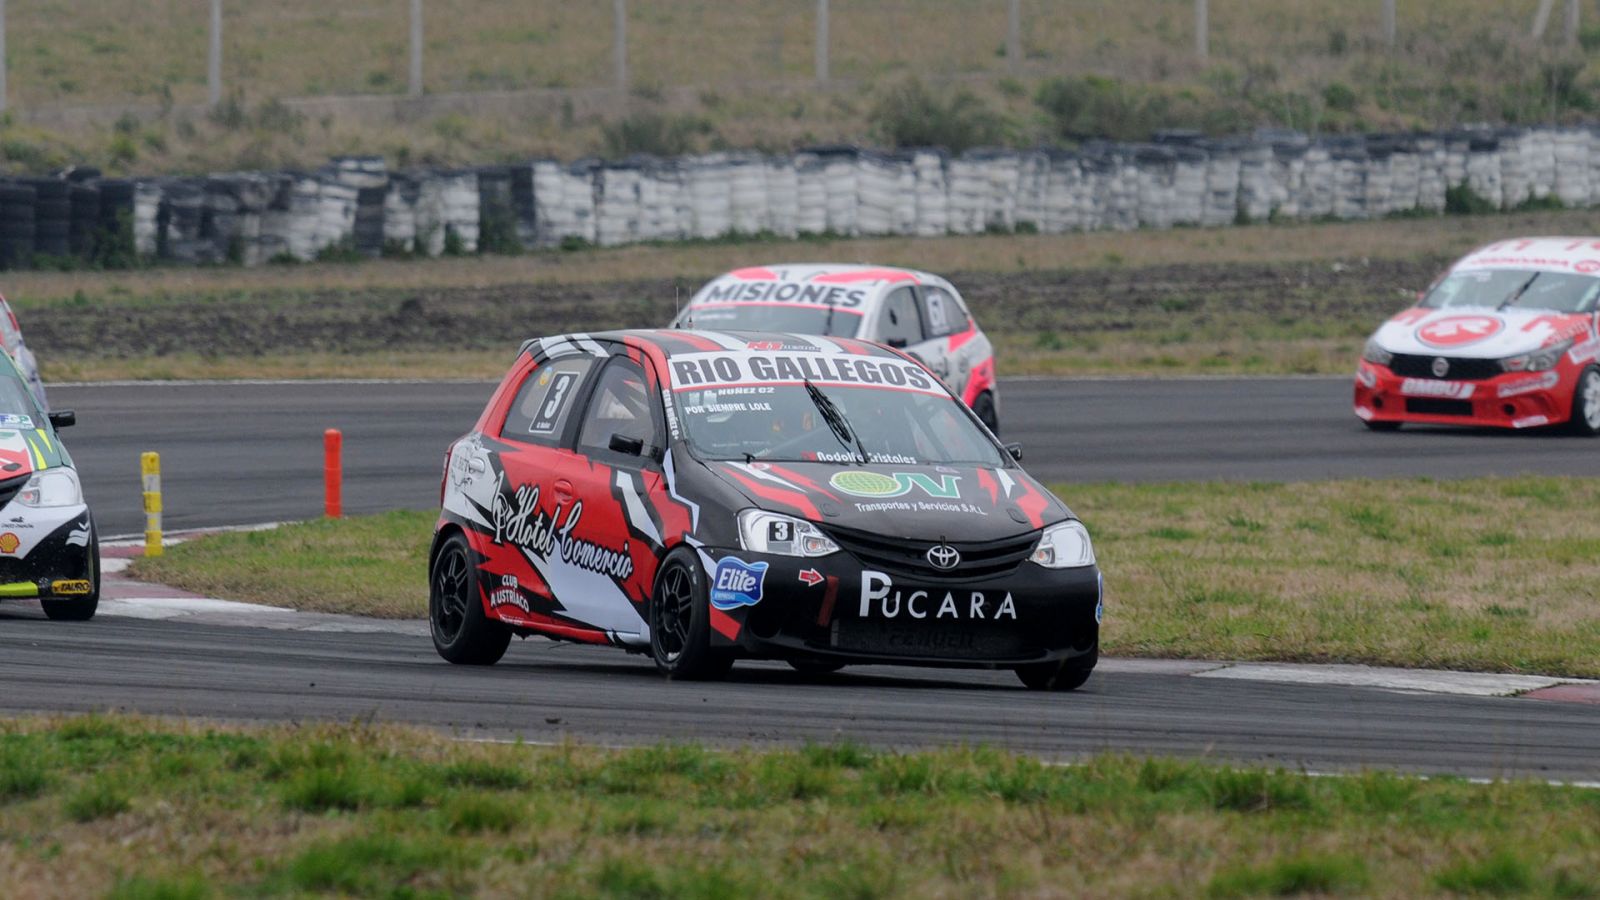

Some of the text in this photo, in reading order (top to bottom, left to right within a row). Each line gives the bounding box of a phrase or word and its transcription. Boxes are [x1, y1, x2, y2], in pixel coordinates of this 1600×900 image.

[704, 282, 867, 307] MISIONES
[672, 357, 742, 385] RIO
[748, 357, 931, 390] GALLEGOS
[544, 375, 570, 419] 3
[685, 406, 705, 414] POR
[749, 402, 772, 411] LOLE
[855, 502, 910, 513] Transportes
[911, 504, 917, 512] y
[919, 502, 960, 512] Servicios
[506, 485, 633, 579] Hotel Comercio
[774, 522, 788, 541] 3
[502, 575, 518, 589] CLUB
[717, 567, 756, 592] Elite
[859, 570, 1017, 620] PUCARA
